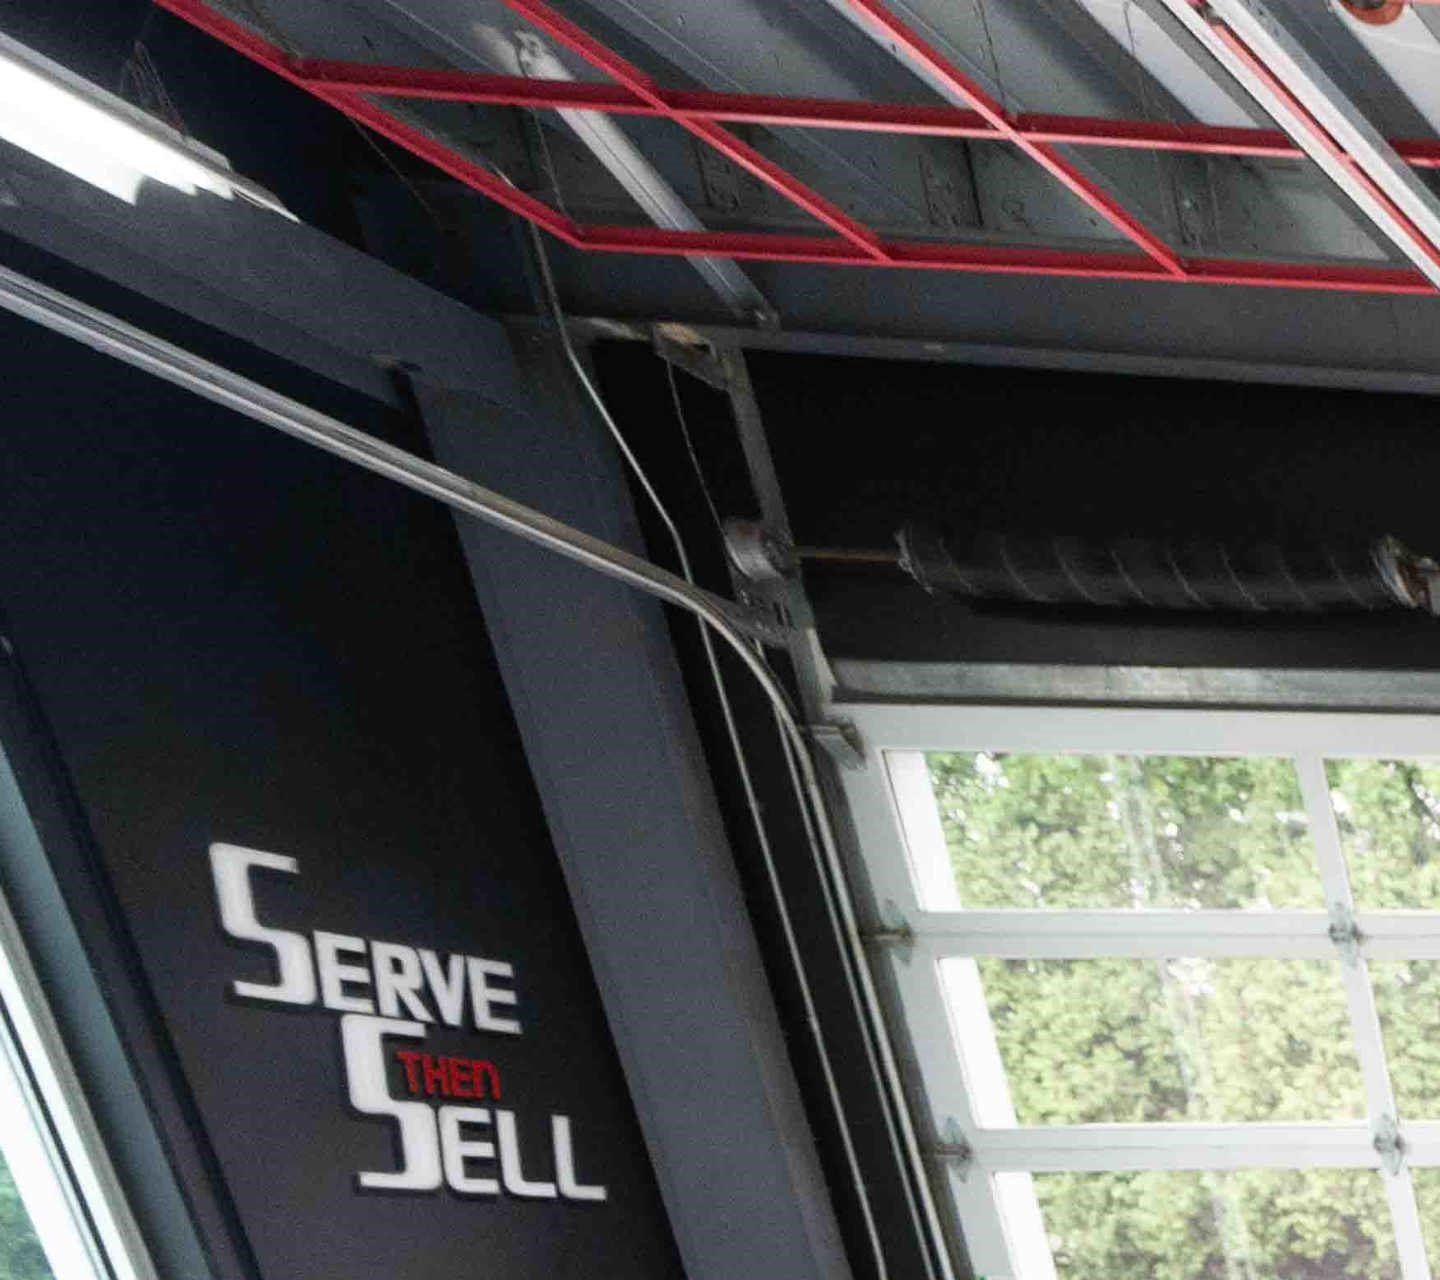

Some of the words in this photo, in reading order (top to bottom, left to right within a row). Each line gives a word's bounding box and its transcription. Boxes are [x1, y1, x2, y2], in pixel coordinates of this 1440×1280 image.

[208, 841, 523, 1035] SERVE
[340, 1013, 607, 1201] SELL
[395, 1050, 502, 1099] THEN
